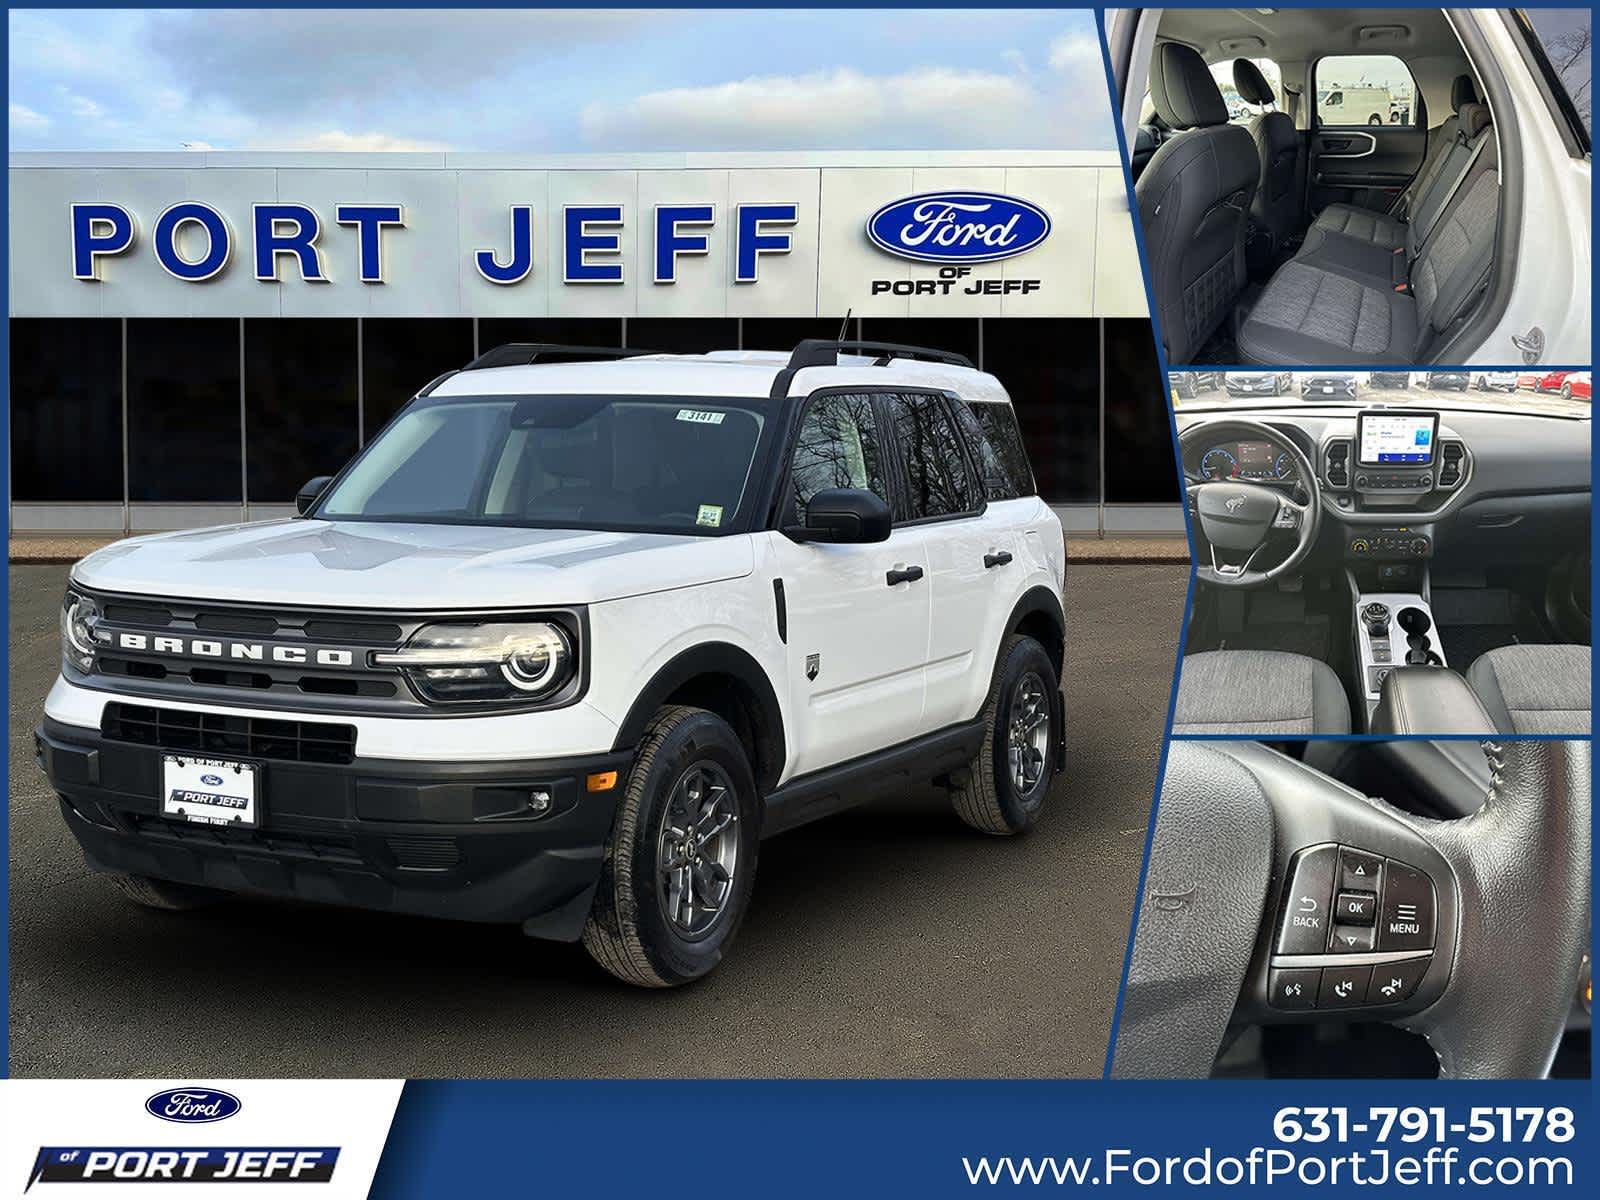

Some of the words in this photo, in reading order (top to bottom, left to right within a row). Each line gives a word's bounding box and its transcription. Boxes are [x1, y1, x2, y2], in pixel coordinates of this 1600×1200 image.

[900, 201, 1021, 247] Ford
[70, 202, 406, 282] PORT
[475, 203, 800, 284] JEFF
[939, 267, 971, 279] OF
[871, 281, 956, 295] PORT
[964, 280, 1041, 295] JEFF
[687, 412, 713, 421] 3141
[119, 633, 353, 666] BRONCO
[183, 792, 216, 804] PORT
[217, 795, 245, 808] JEFF
[1349, 902, 1363, 913] OK
[1293, 917, 1319, 928] BACK
[1390, 923, 1419, 934] MENU
